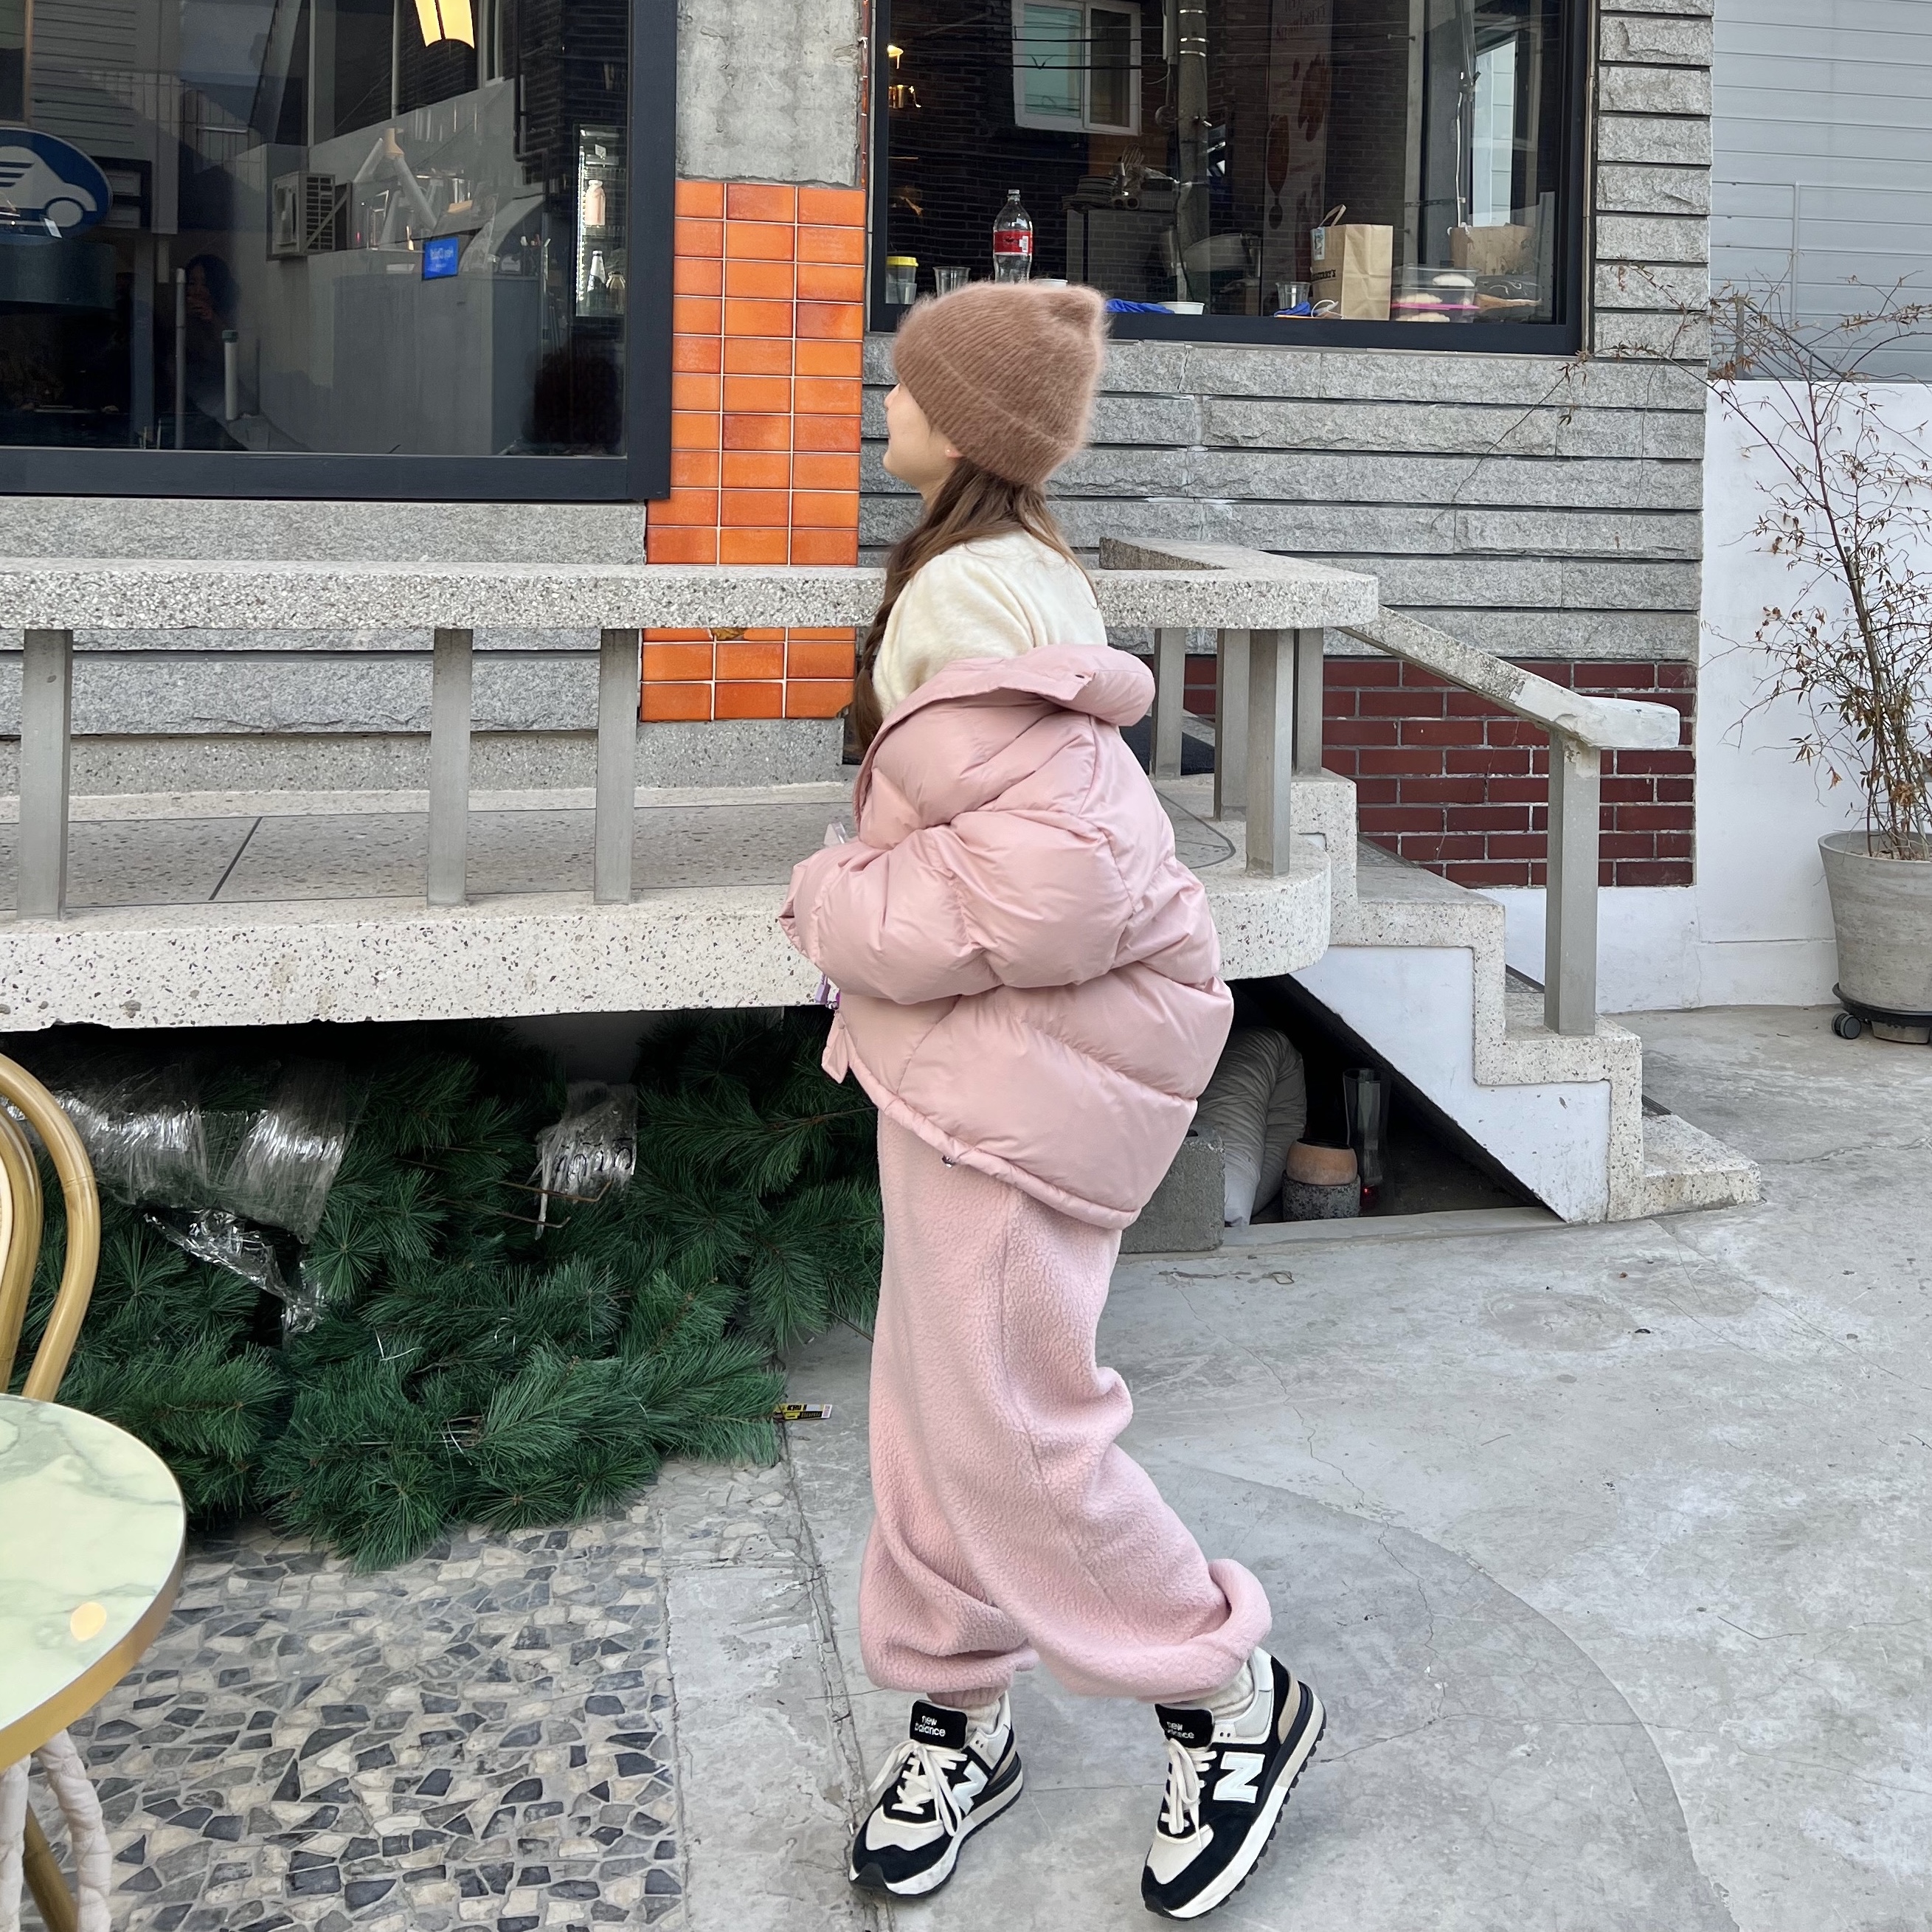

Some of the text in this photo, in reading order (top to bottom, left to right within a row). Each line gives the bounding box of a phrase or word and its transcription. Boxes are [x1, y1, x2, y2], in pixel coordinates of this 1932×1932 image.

[921, 1715, 937, 1725] new
[915, 1722, 946, 1737] balance
[1213, 1751, 1265, 1804] N
